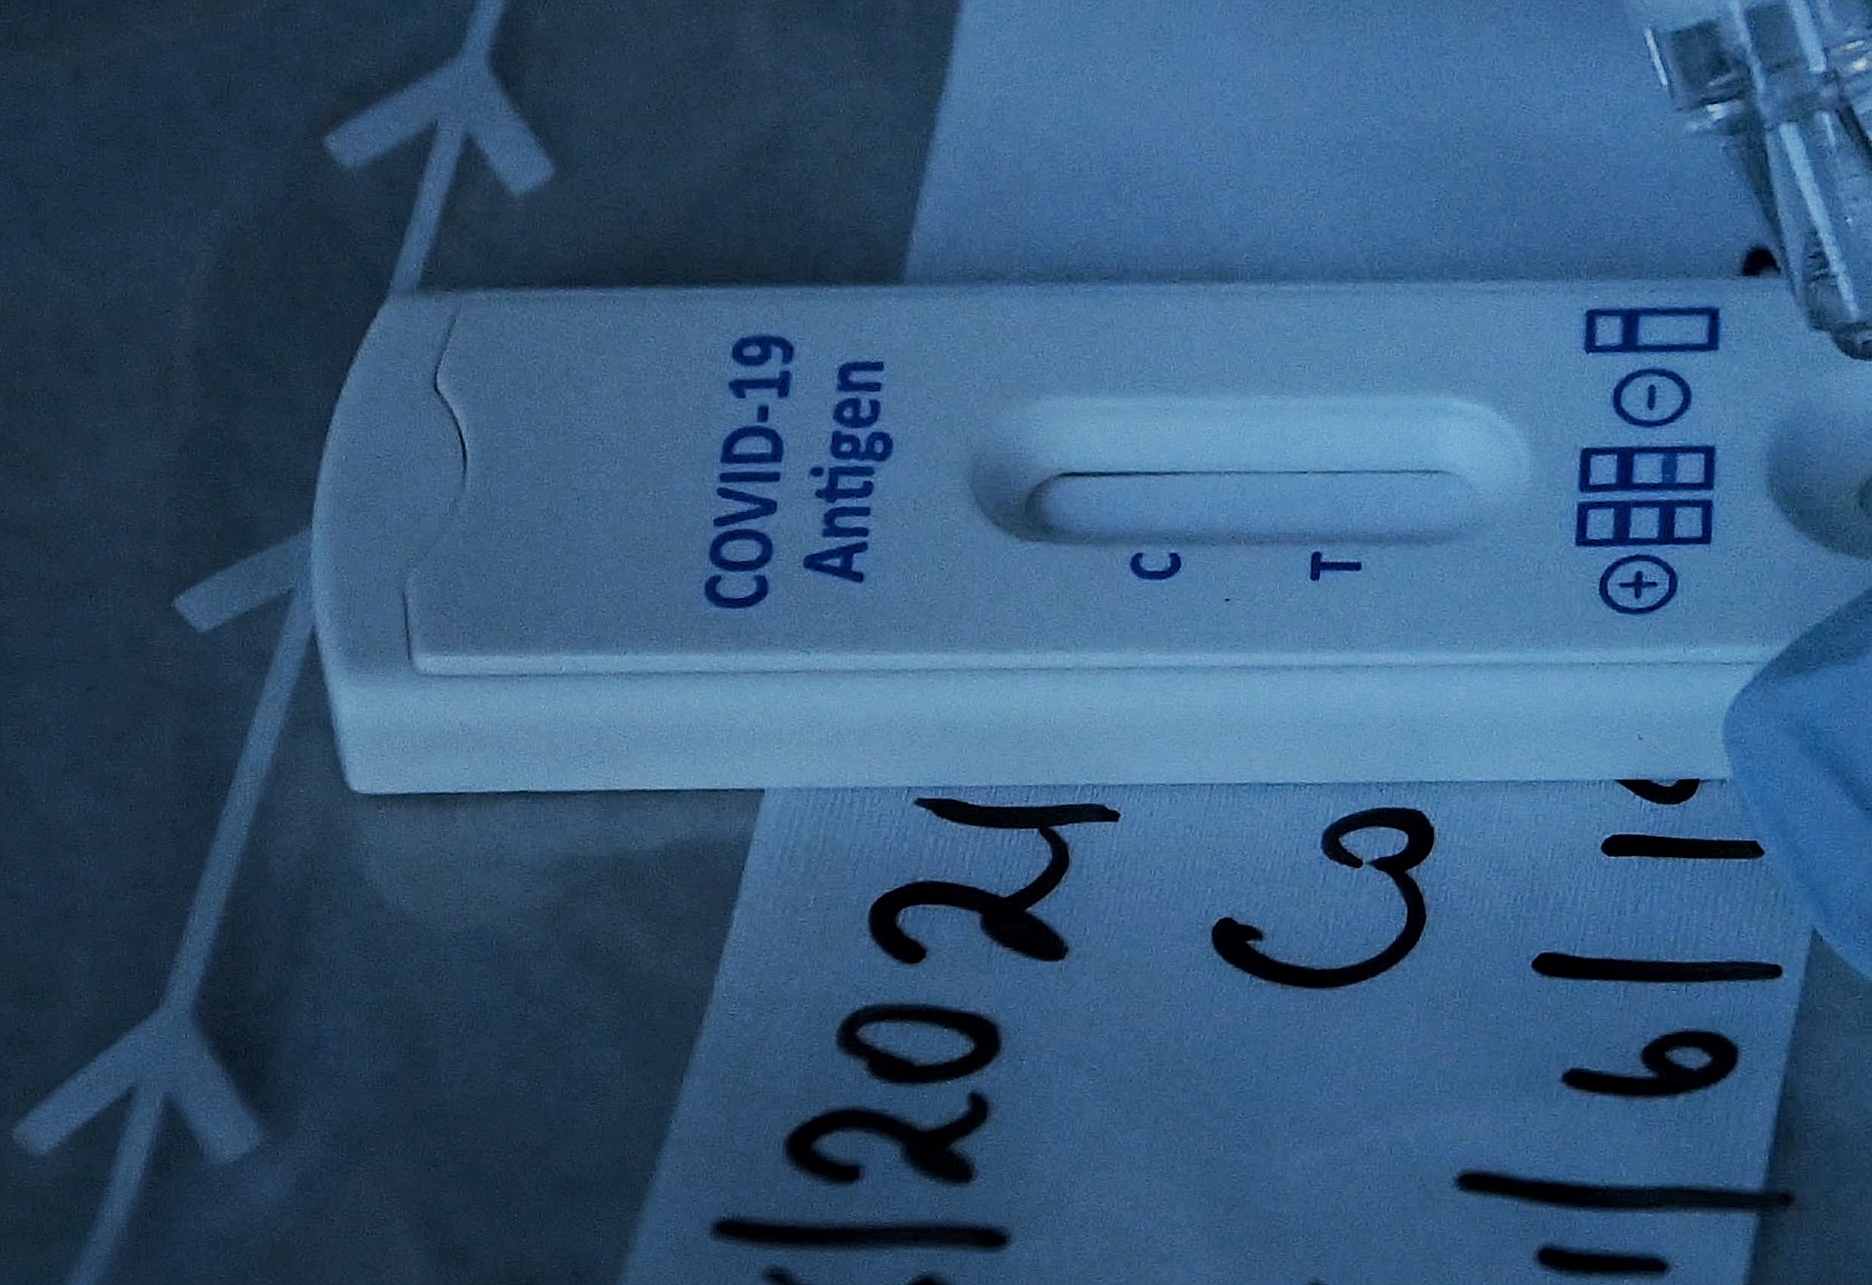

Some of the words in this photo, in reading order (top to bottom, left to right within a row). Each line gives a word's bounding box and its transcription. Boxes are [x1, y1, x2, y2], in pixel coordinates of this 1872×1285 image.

[704, 334, 794, 609] COVID-19
[803, 360, 893, 583] Antigen
[1130, 551, 1182, 581] C
[1310, 551, 1362, 581] T
